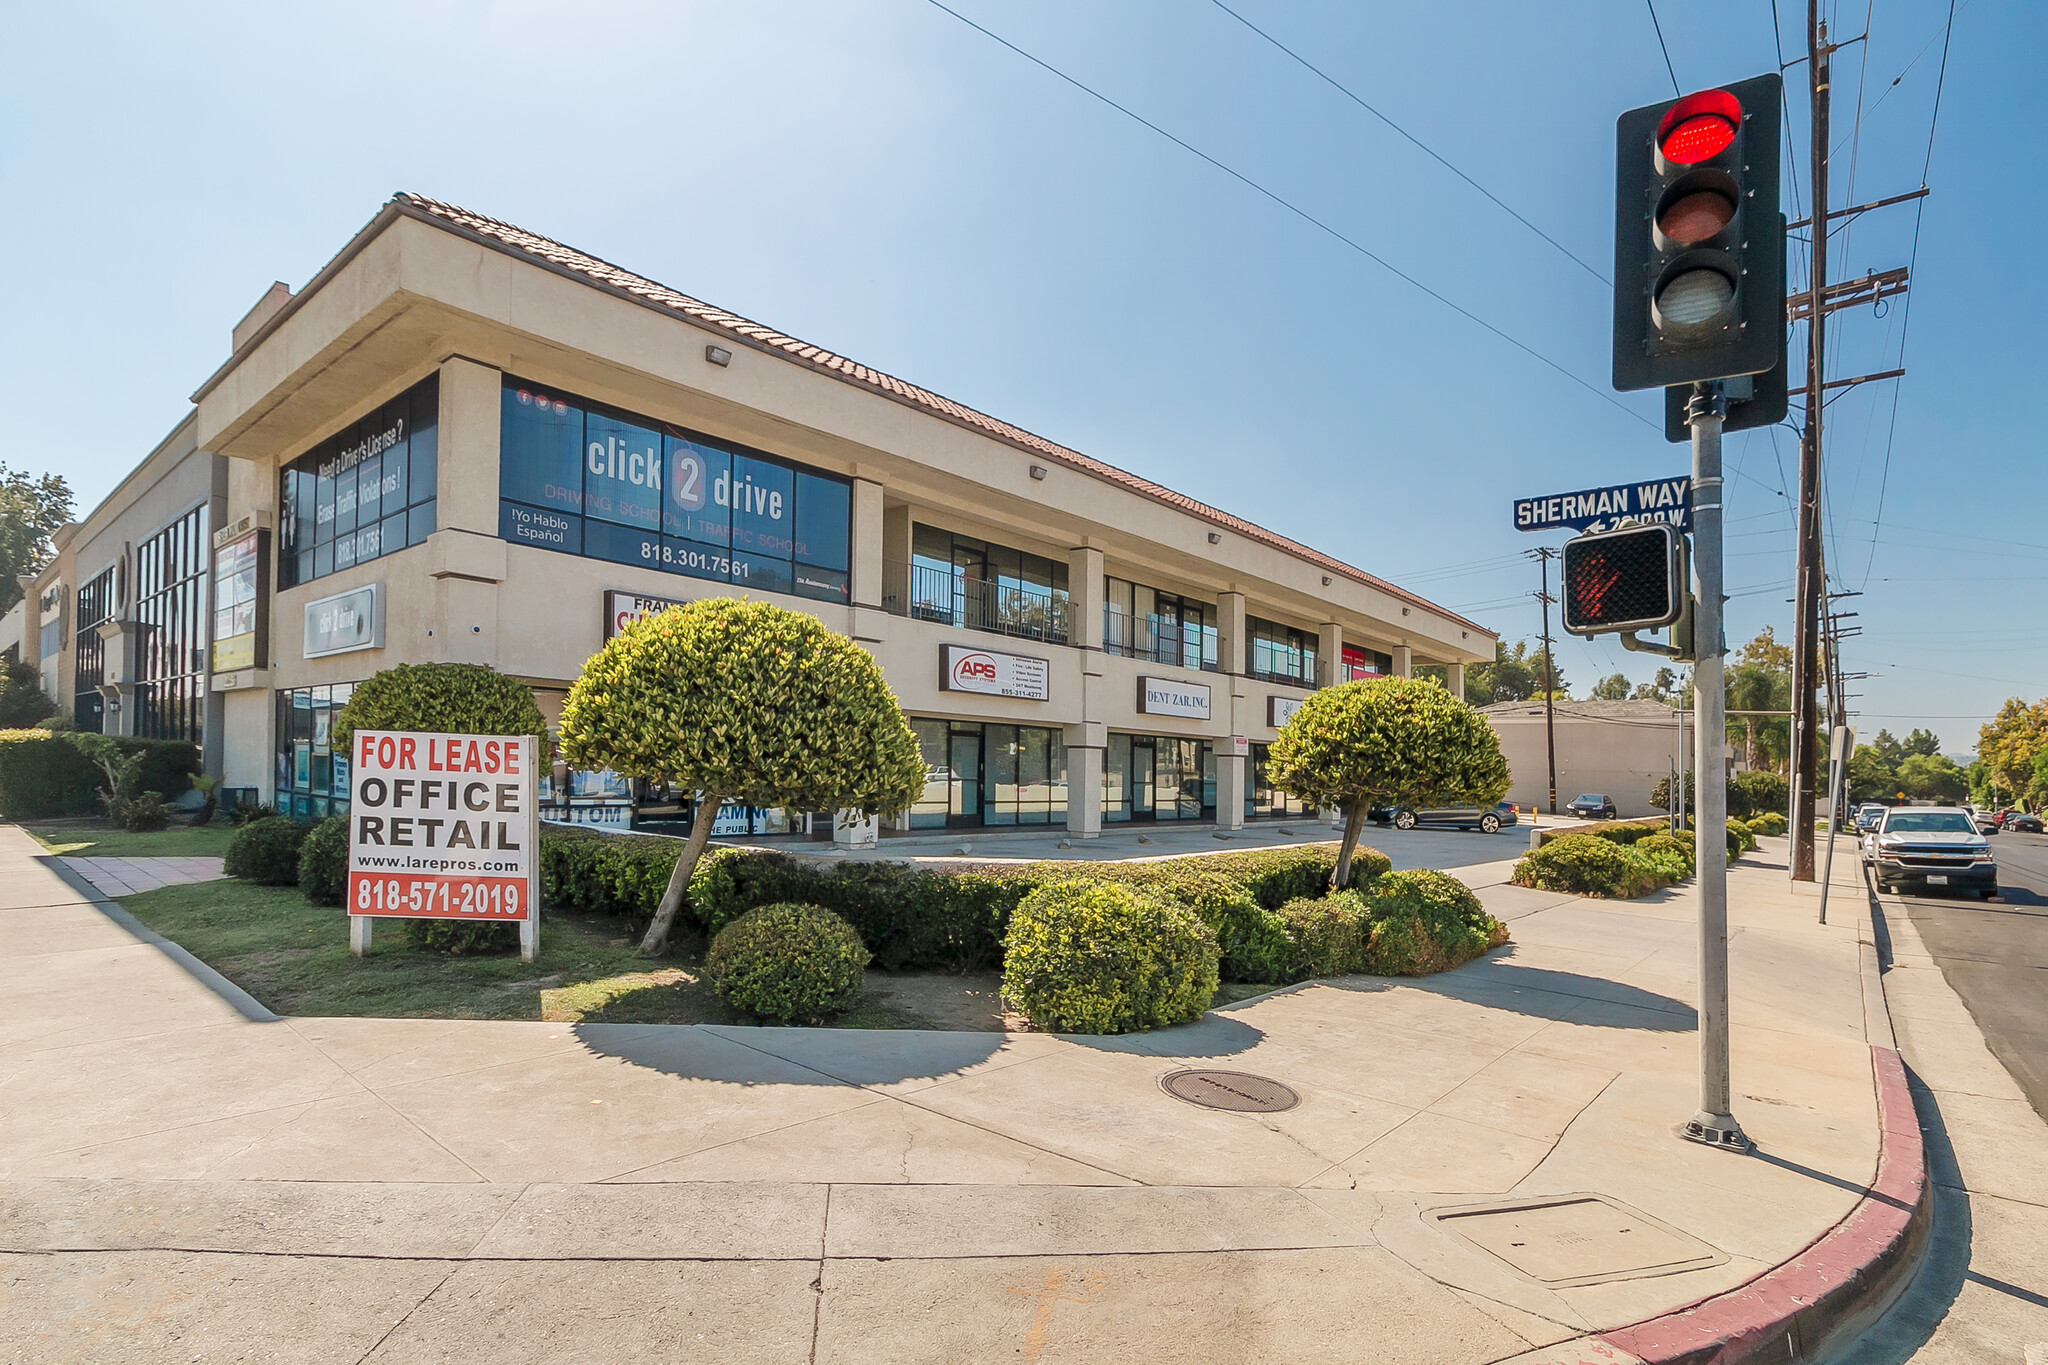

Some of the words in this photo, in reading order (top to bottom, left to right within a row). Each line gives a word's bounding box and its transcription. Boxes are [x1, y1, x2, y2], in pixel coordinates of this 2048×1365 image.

[319, 457, 335, 482] Need
[336, 458, 340, 475] a
[341, 441, 366, 472] Driver's
[587, 436, 662, 491] click
[679, 457, 699, 502] 2
[713, 469, 783, 520] drive
[317, 503, 335, 525] Erase
[336, 490, 357, 515] Traffic
[544, 483, 611, 511] DRIVING
[619, 501, 681, 527] SCHOOL
[1517, 488, 1628, 525] SHERMAN
[1637, 479, 1688, 510] WAY
[1609, 511, 1665, 531] 2100
[1668, 508, 1687, 527] W.
[517, 524, 563, 543] Español
[533, 513, 568, 530] Hablo
[698, 520, 753, 543] TRAFFIC
[758, 533, 809, 556] SCHOOL
[641, 542, 749, 578] 818.301.7561
[960, 661, 996, 679] APS
[1001, 688, 1042, 698] 855-311-4277
[1147, 690, 1170, 704] DENT
[360, 736, 416, 770] FOR
[428, 738, 520, 775] LEASE
[360, 777, 520, 813] OFFICE
[358, 815, 521, 851] RETAIL
[726, 825, 758, 834] PUBLC
[358, 855, 519, 872] www.larepros.com
[357, 878, 519, 914] 818-571-2019
